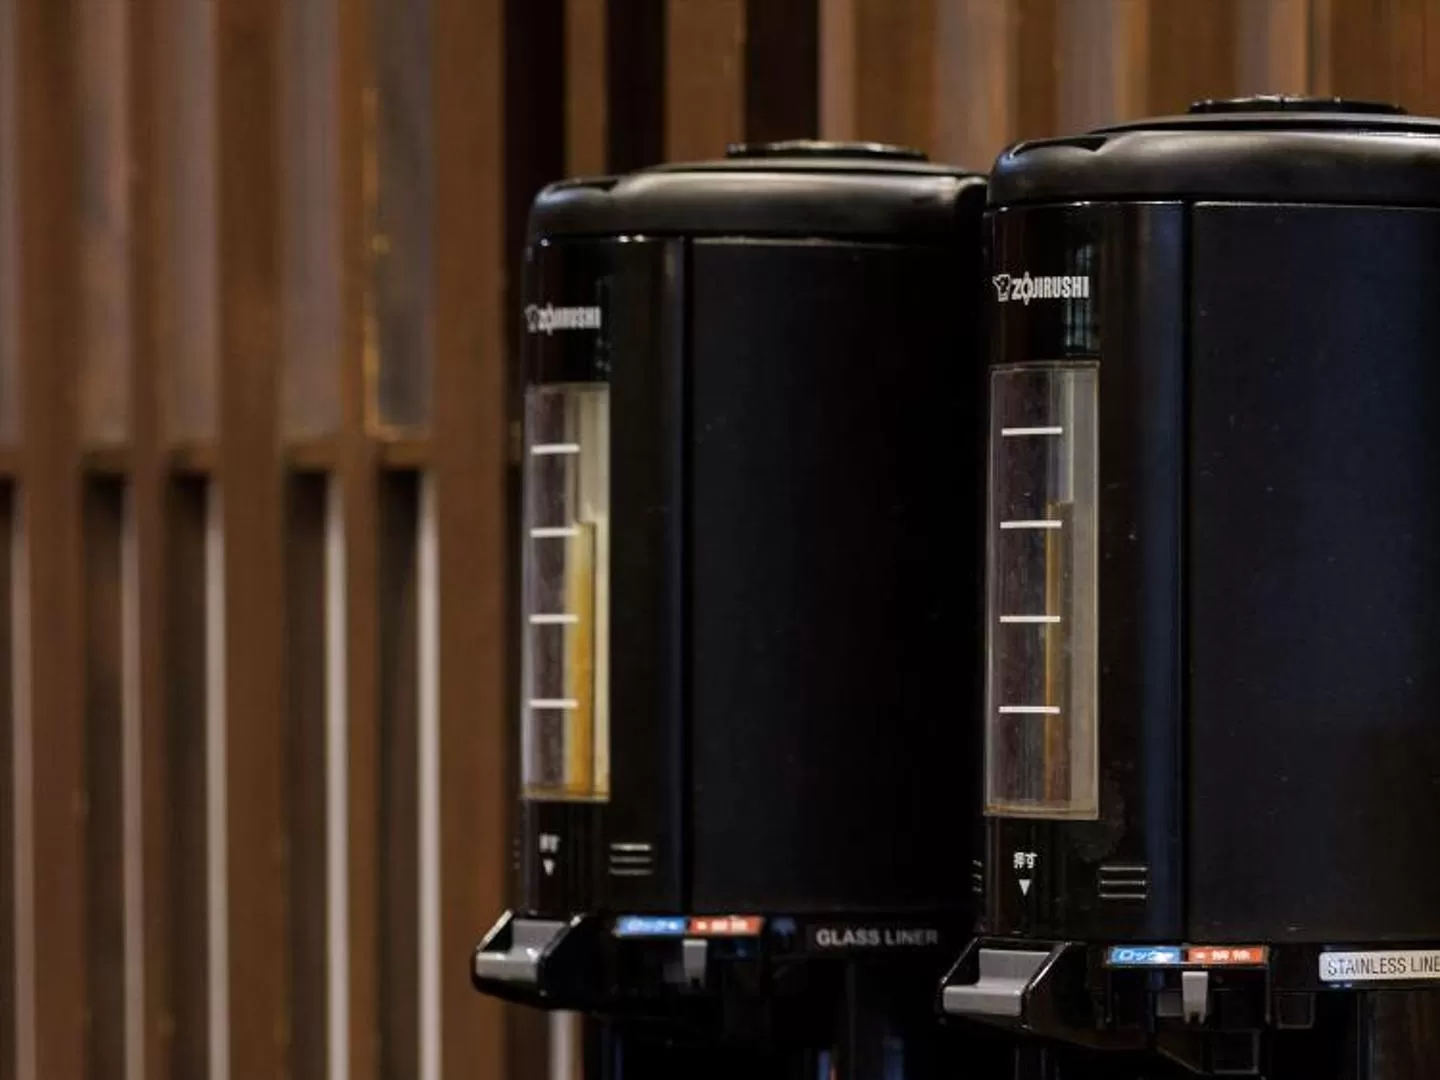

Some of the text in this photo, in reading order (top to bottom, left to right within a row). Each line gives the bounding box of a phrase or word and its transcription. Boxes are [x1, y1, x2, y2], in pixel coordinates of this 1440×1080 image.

[1011, 272, 1090, 304] ZOJIRUSHI
[816, 928, 938, 947] GLASS LINER
[1327, 956, 1407, 975] STAINLESS
